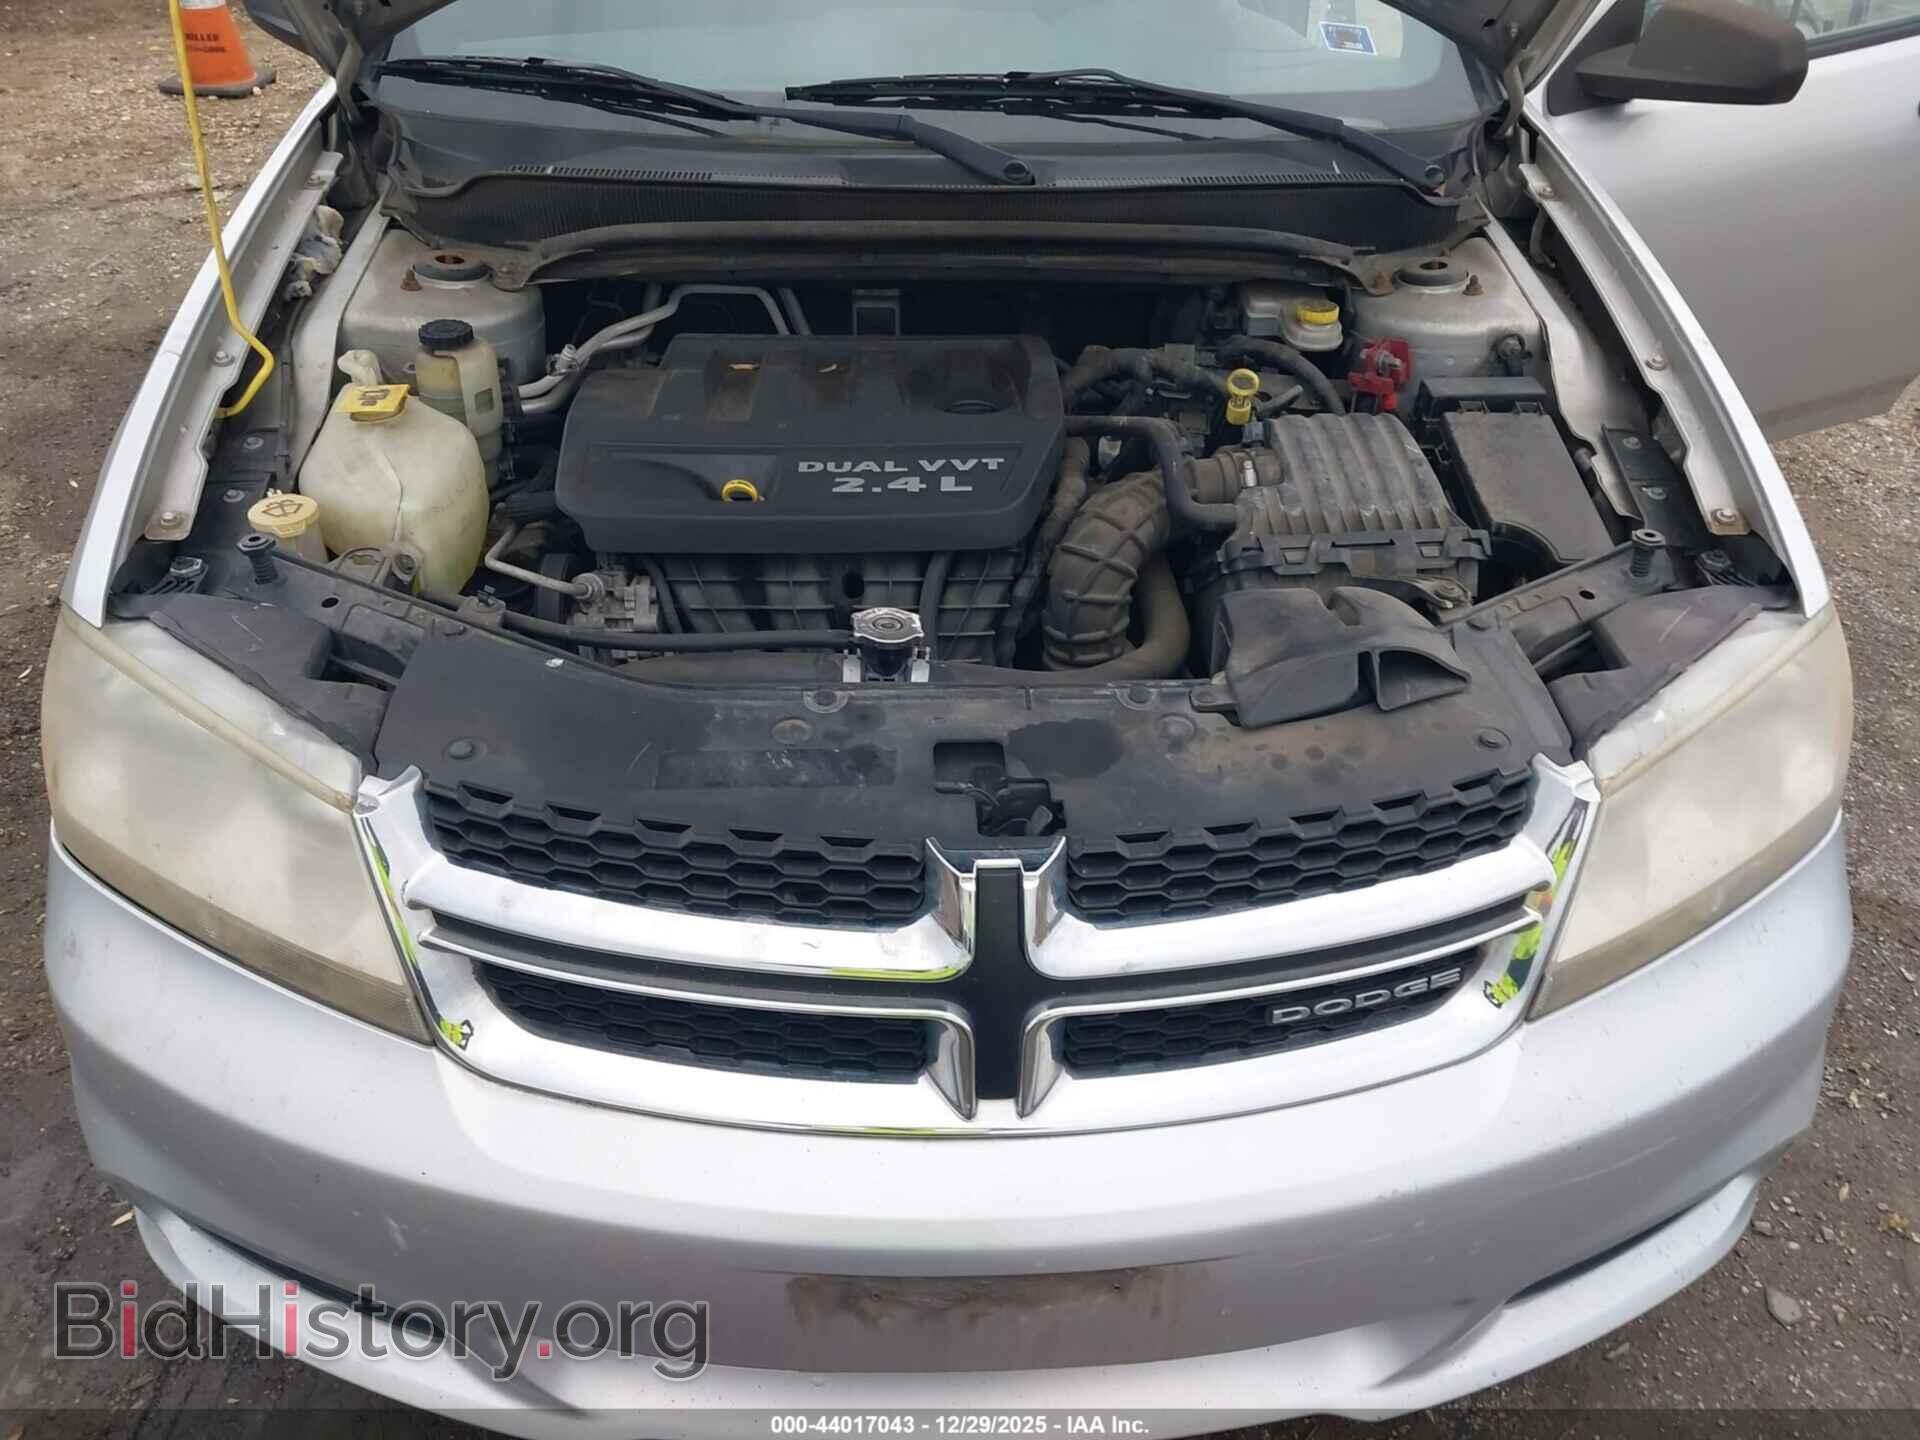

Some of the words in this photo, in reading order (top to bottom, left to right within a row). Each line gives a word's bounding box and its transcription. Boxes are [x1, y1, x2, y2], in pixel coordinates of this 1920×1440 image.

[798, 460, 909, 473] DUAL
[918, 458, 1005, 472] VVT
[1270, 967, 1462, 1025] DODGE
